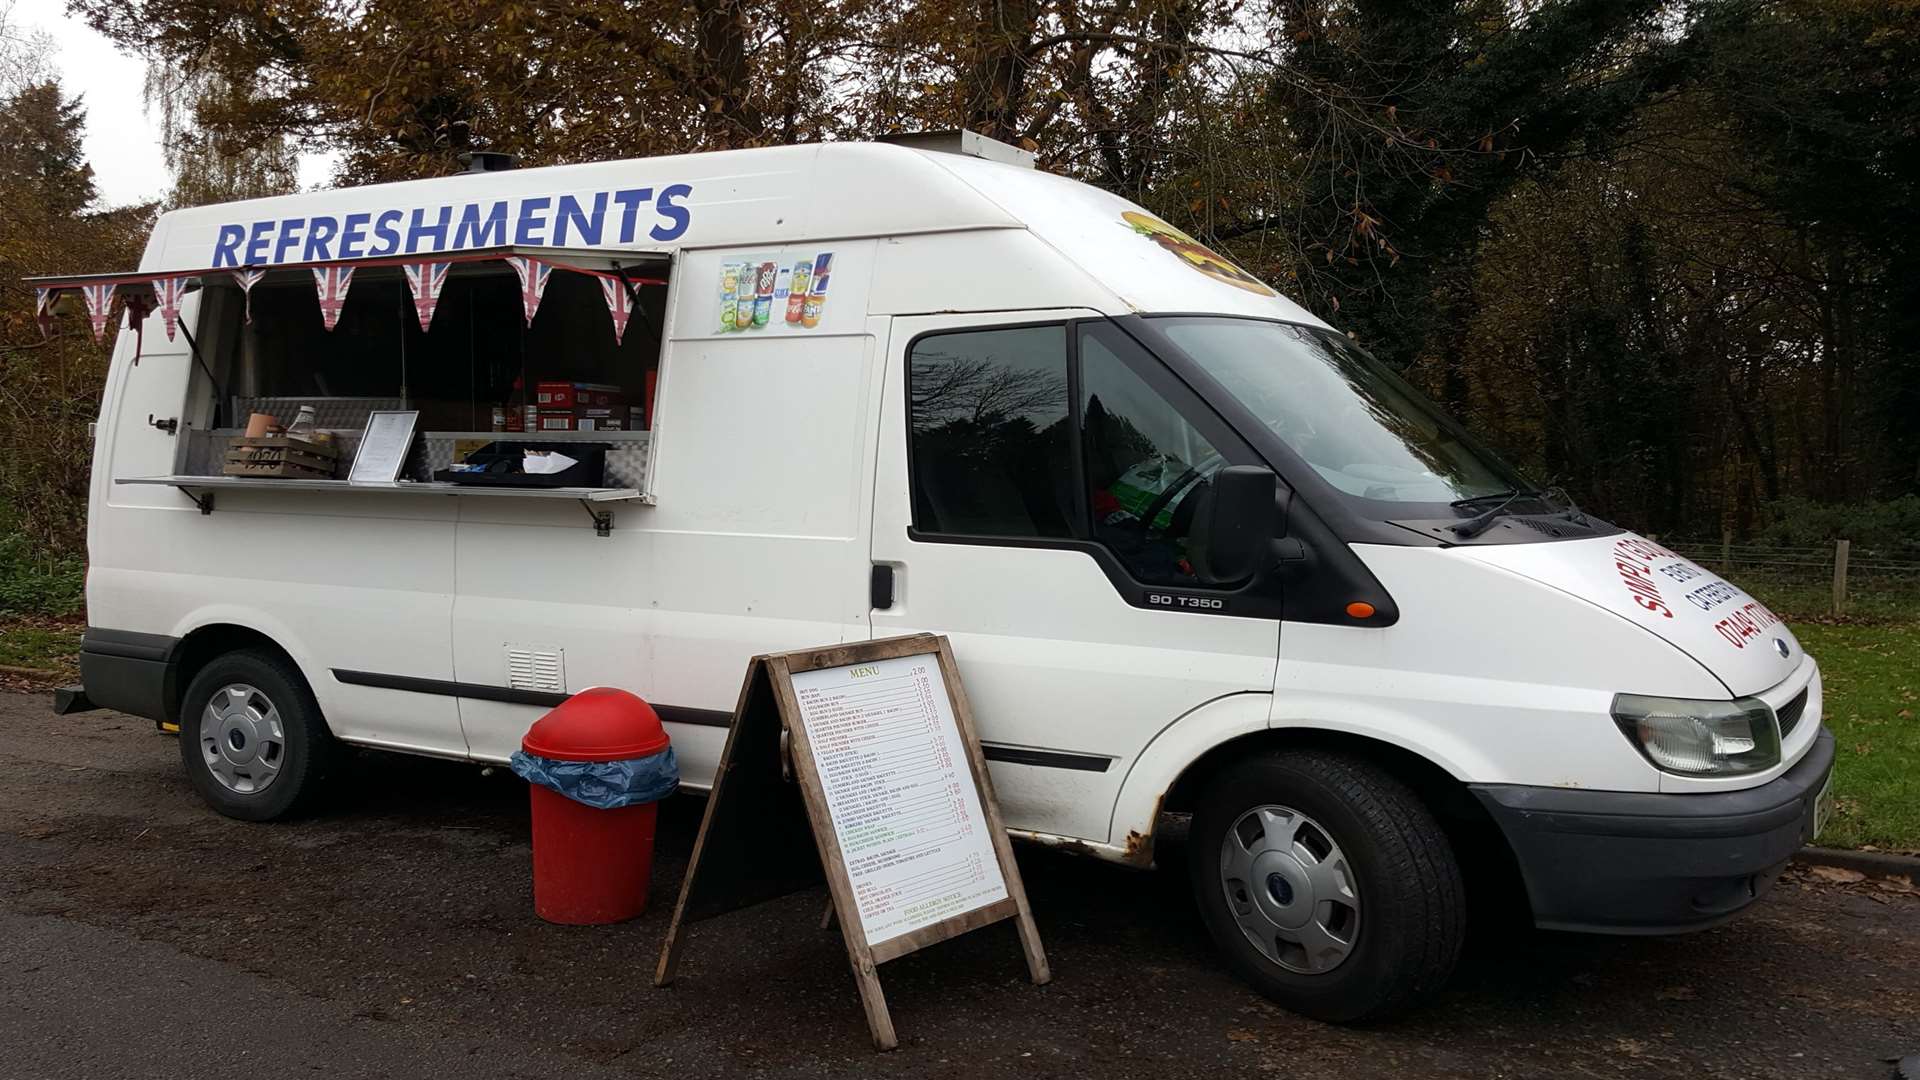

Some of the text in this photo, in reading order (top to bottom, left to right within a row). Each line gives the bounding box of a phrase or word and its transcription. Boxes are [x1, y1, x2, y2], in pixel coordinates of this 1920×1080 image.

[212, 184, 692, 268] REFRESHMENTS
[1149, 594, 1223, 609] 90 T350
[1613, 547, 1674, 619] SIMPLY
[850, 665, 880, 679] MENU
